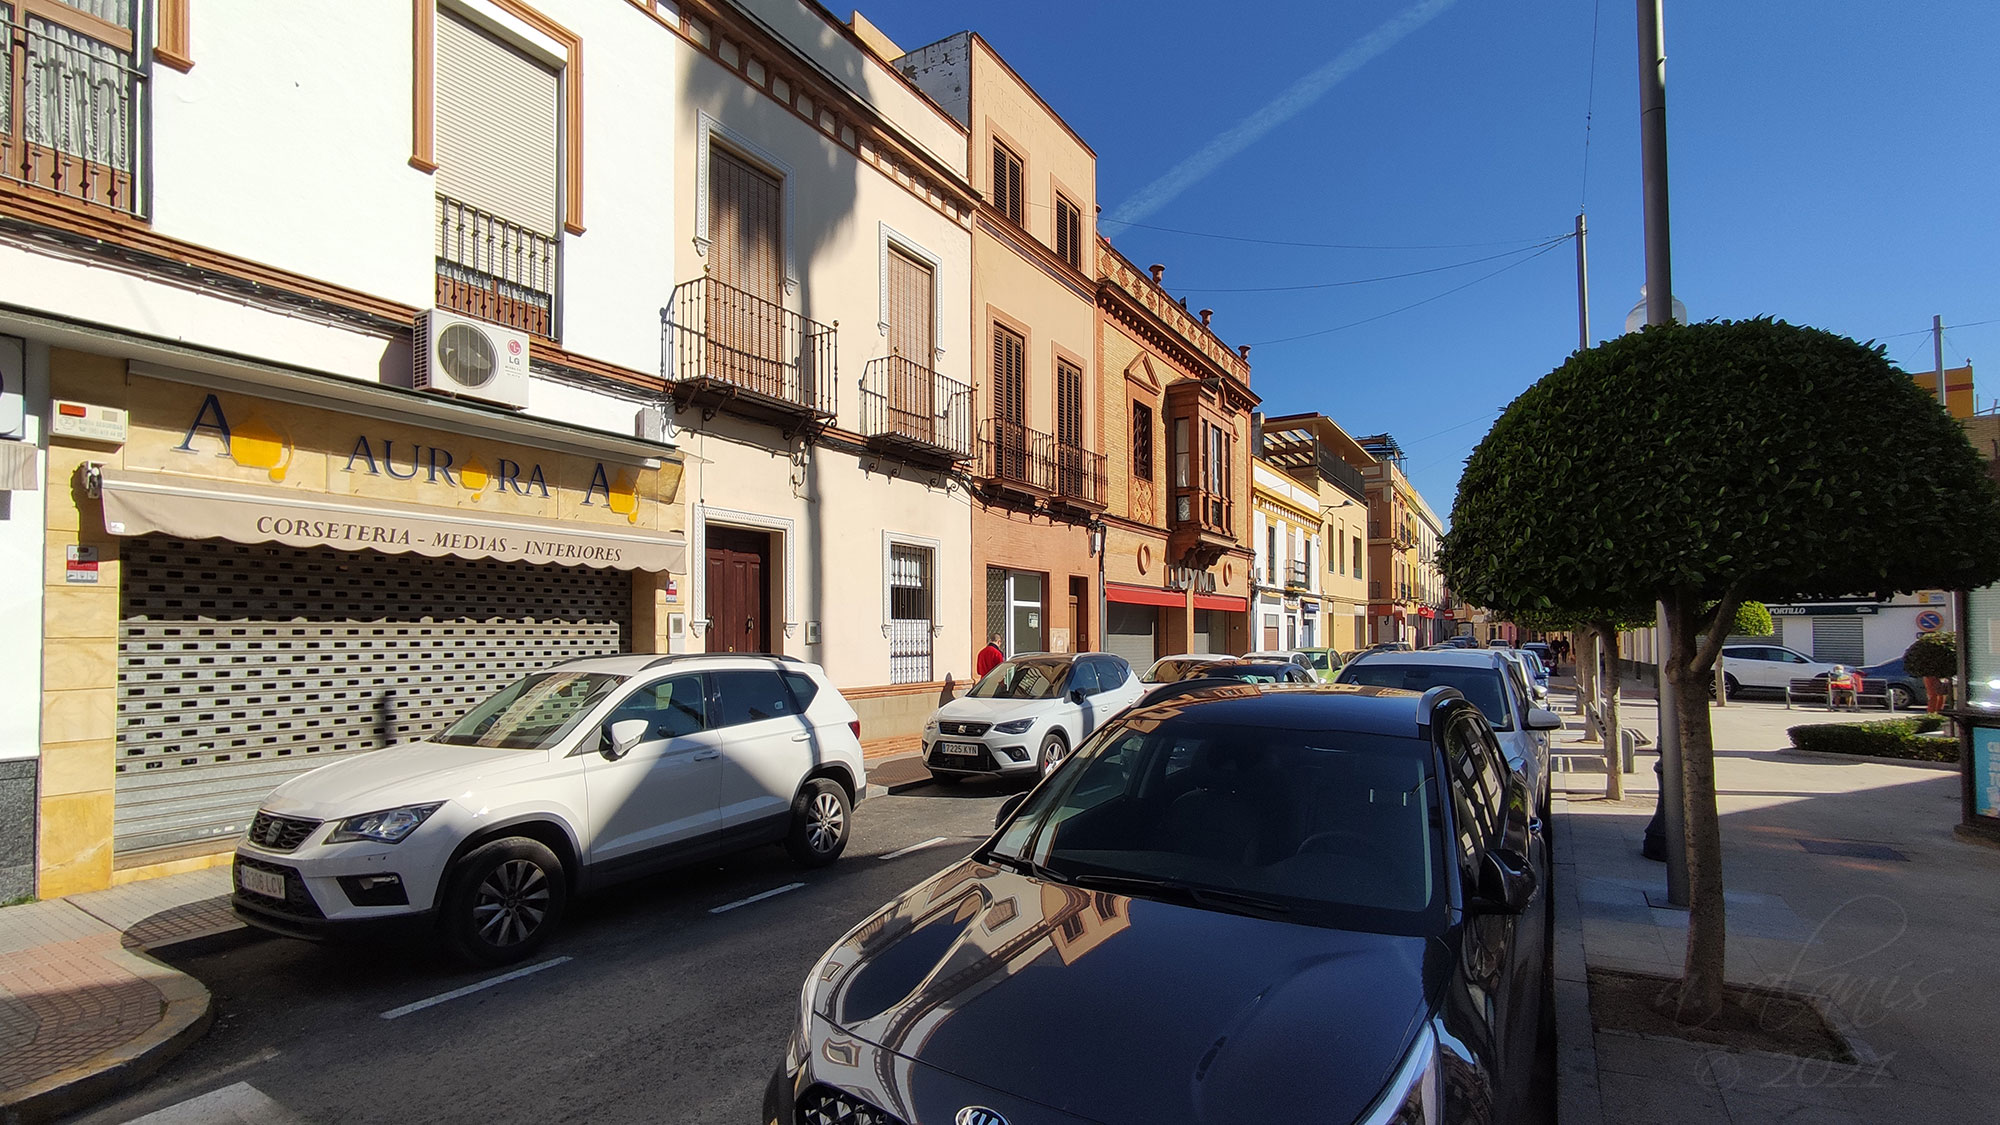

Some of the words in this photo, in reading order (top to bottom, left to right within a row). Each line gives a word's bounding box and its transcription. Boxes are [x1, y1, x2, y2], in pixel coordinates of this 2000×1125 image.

[508, 355, 520, 366] LG
[256, 516, 411, 545] CORSETERIA
[431, 532, 508, 553] MEDIAS
[524, 540, 622, 562] INTERIORES
[1769, 607, 1806, 615] PORTILLO
